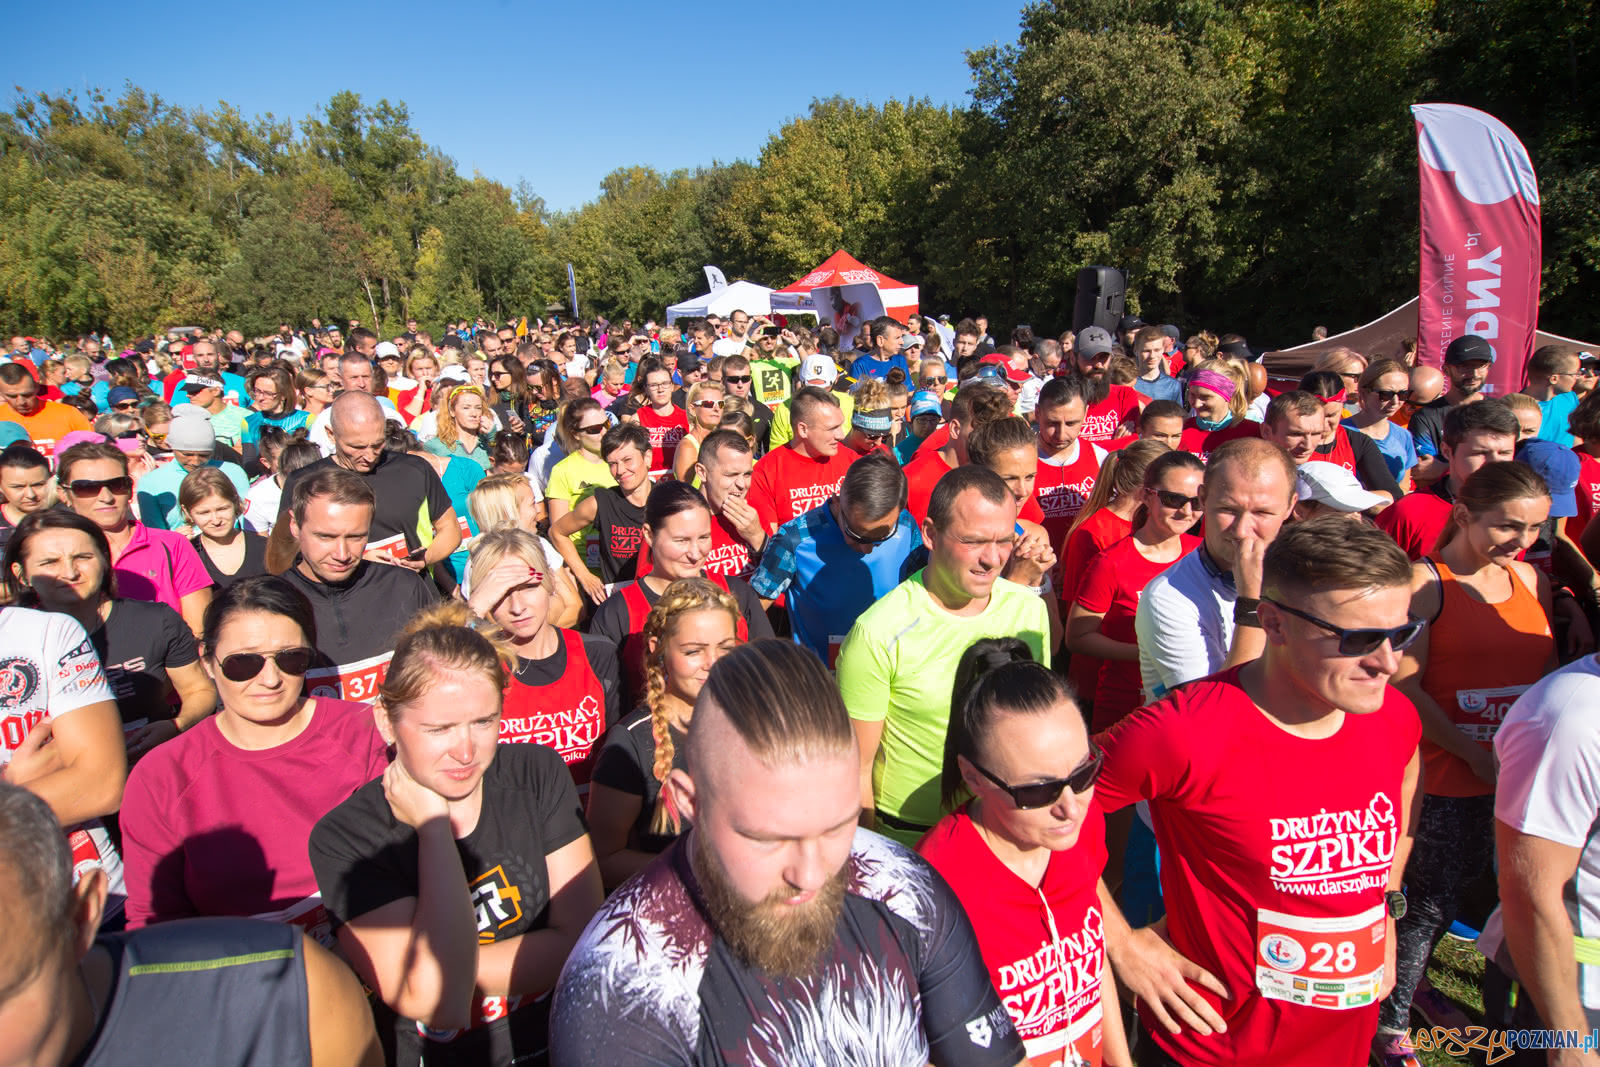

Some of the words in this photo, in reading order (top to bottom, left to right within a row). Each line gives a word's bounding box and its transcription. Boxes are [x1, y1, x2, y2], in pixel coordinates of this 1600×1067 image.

[1079, 421, 1119, 435] ZPIKU
[1039, 482, 1086, 496] DRUŻYNA
[611, 525, 645, 536] DRUŻY
[611, 536, 642, 550] SZP
[1269, 808, 1379, 841] DRUŻYNA
[1270, 827, 1397, 878] SZPIKU
[1273, 869, 1390, 896] www.darszpiku.pl
[1308, 941, 1357, 973] 28
